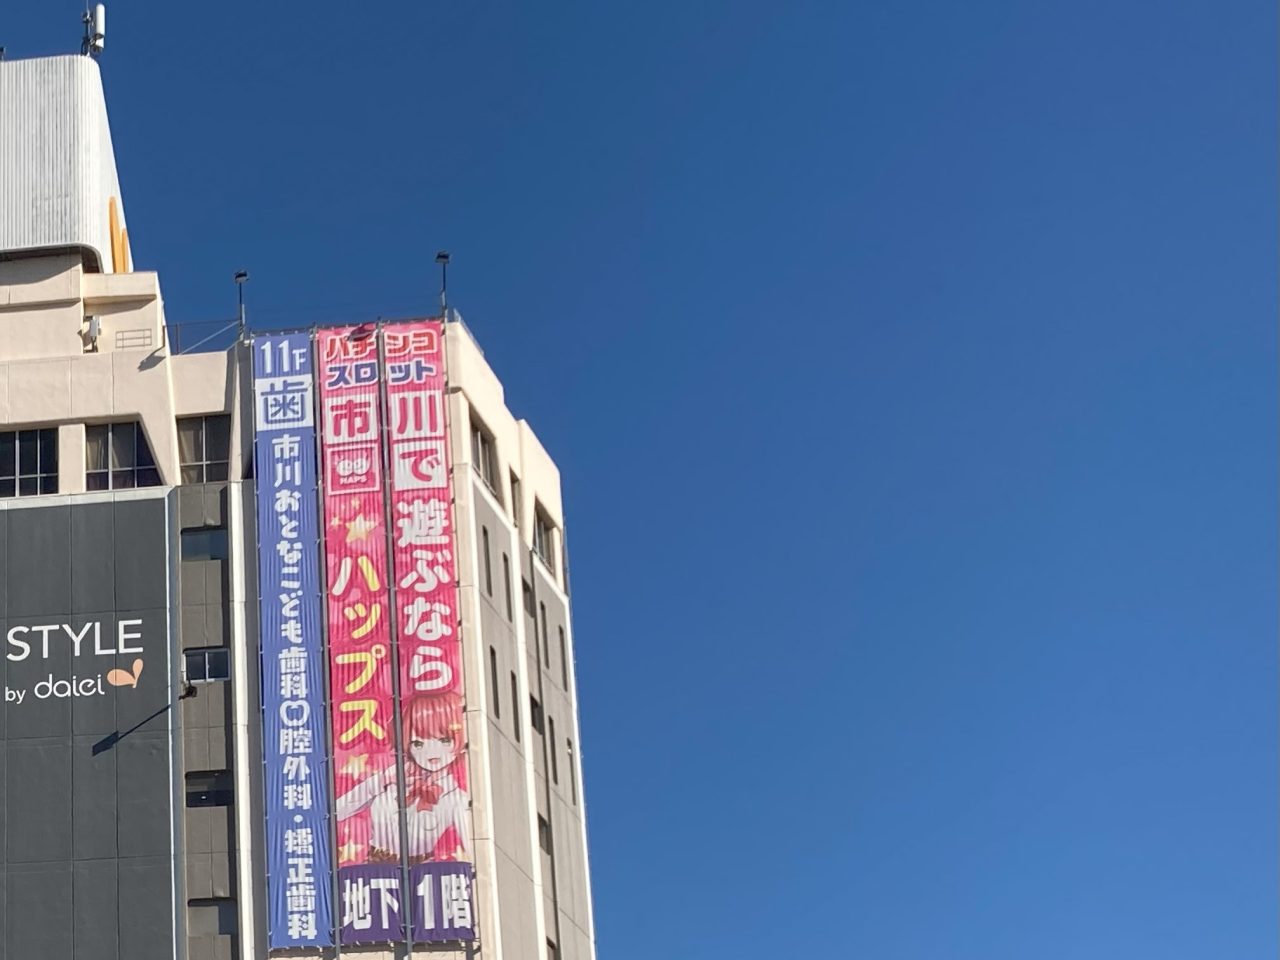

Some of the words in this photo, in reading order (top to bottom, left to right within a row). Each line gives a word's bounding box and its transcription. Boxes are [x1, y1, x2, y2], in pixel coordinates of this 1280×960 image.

[260, 340, 307, 374] 11F
[260, 380, 308, 424] 歯
[6, 619, 144, 662] STYLE
[331, 555, 385, 744] ハップス
[4, 686, 26, 704] by
[34, 674, 105, 699] daiei
[342, 873, 471, 930] 地下1階
